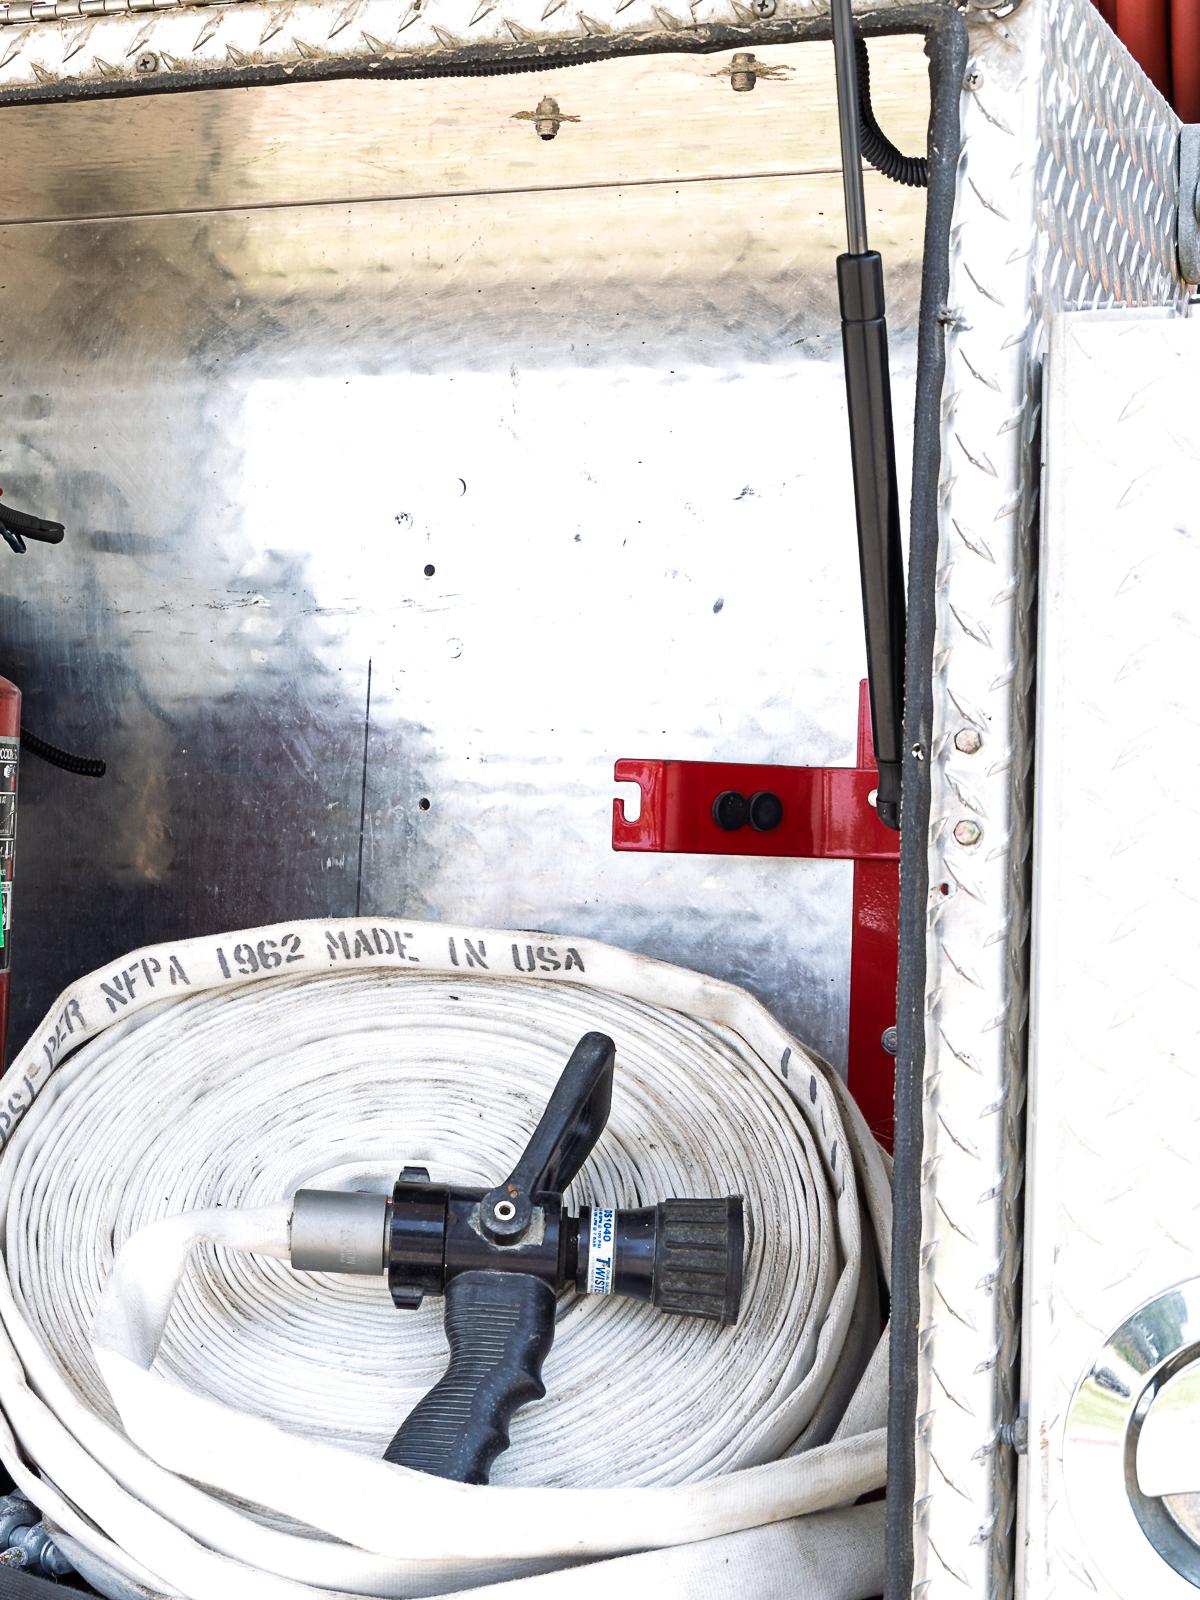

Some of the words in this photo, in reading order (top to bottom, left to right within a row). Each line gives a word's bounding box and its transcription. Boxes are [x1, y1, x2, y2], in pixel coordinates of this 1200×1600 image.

[43, 999, 88, 1070] PER
[99, 955, 191, 1014] NFPA
[216, 933, 305, 980] 1962
[325, 928, 420, 964] MADE
[448, 936, 491, 971] IN
[511, 943, 586, 974] USA
